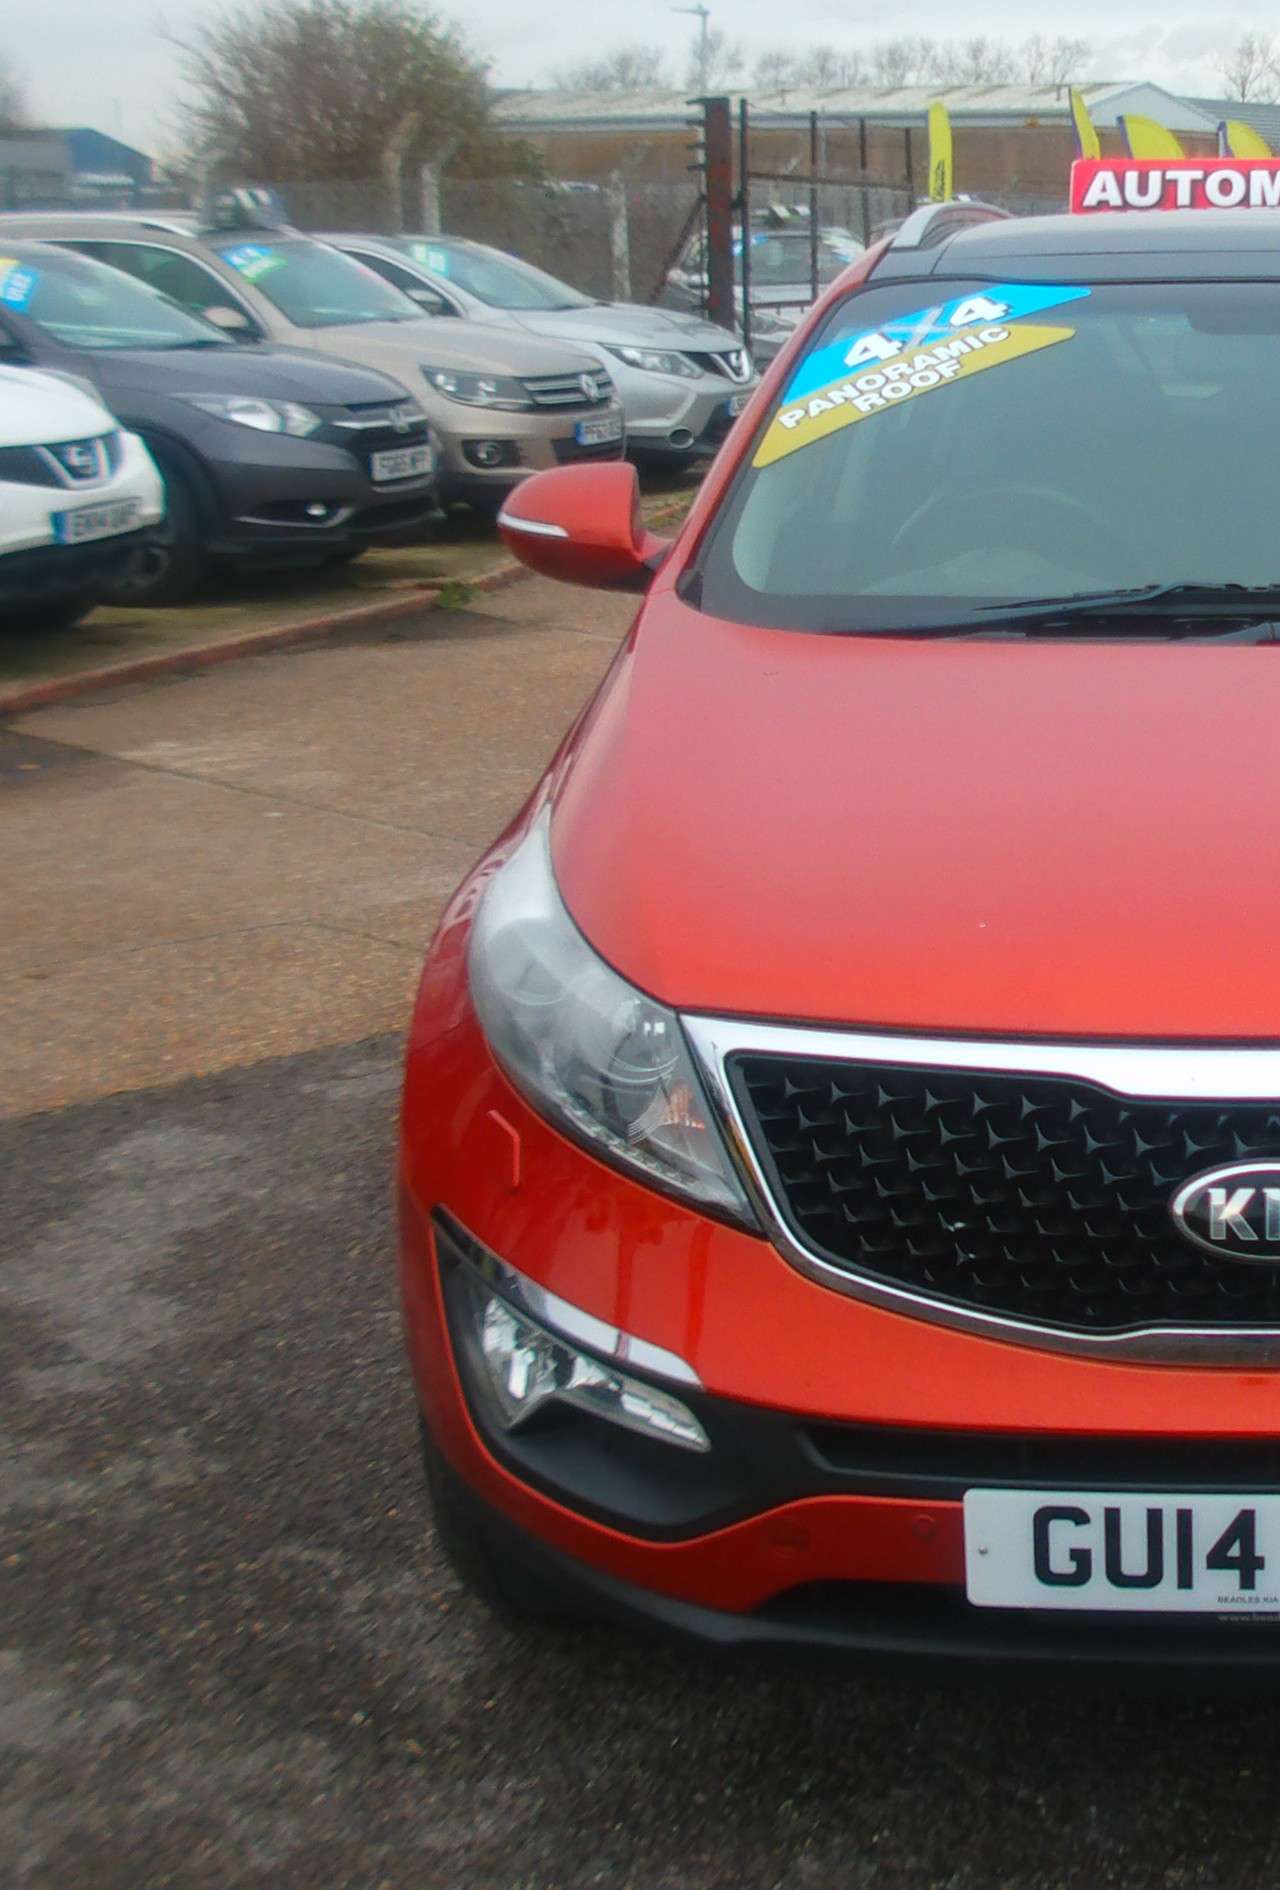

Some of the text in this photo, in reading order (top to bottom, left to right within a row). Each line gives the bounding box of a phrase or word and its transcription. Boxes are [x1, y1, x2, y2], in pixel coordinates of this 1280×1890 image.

[777, 326, 1010, 430] PANORAMIC
[851, 358, 964, 414] ROOF
[1032, 1505, 1265, 1591] GU14
